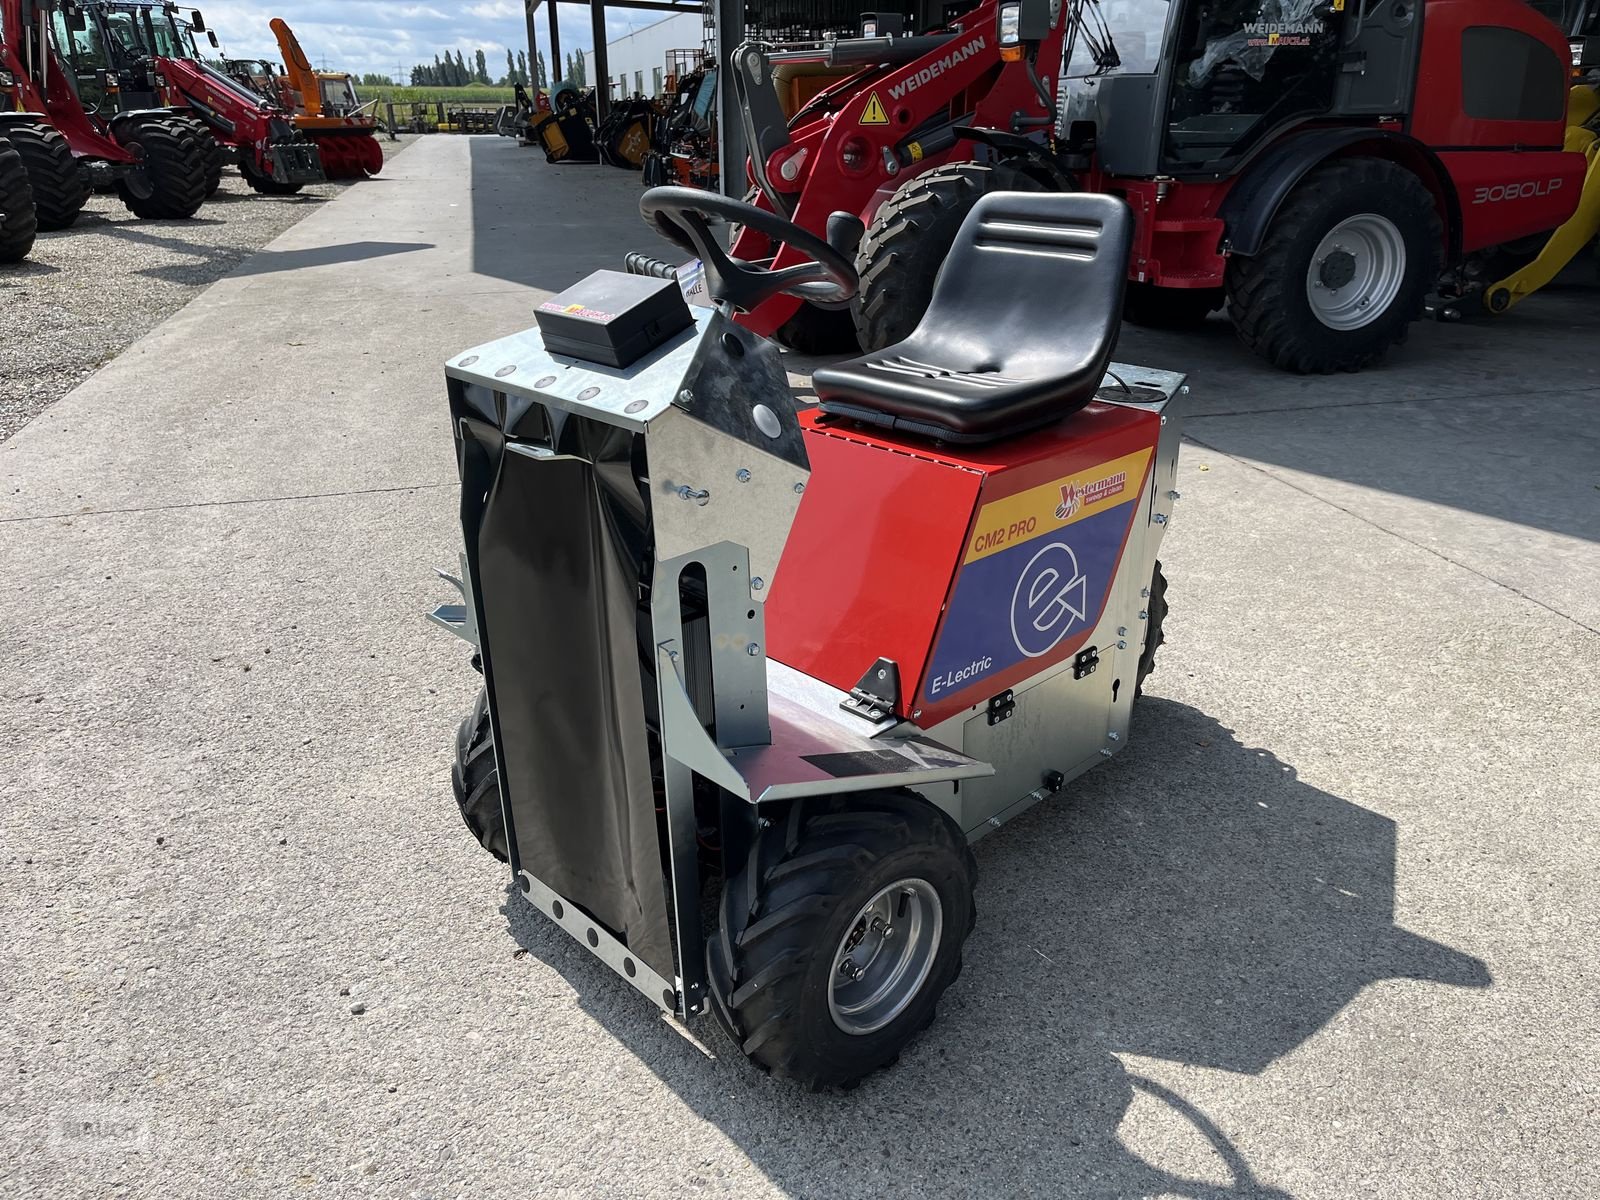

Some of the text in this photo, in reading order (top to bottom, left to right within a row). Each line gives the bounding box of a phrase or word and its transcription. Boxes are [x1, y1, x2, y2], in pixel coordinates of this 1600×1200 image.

[1243, 23, 1323, 33] WEIDEMANN
[887, 35, 986, 100] WEIDEMANN
[1471, 178, 1563, 204] 3080LP
[1060, 472, 1126, 506] Westermann
[974, 516, 1037, 553] CM2 PRO
[931, 655, 993, 695] E-Lectric
